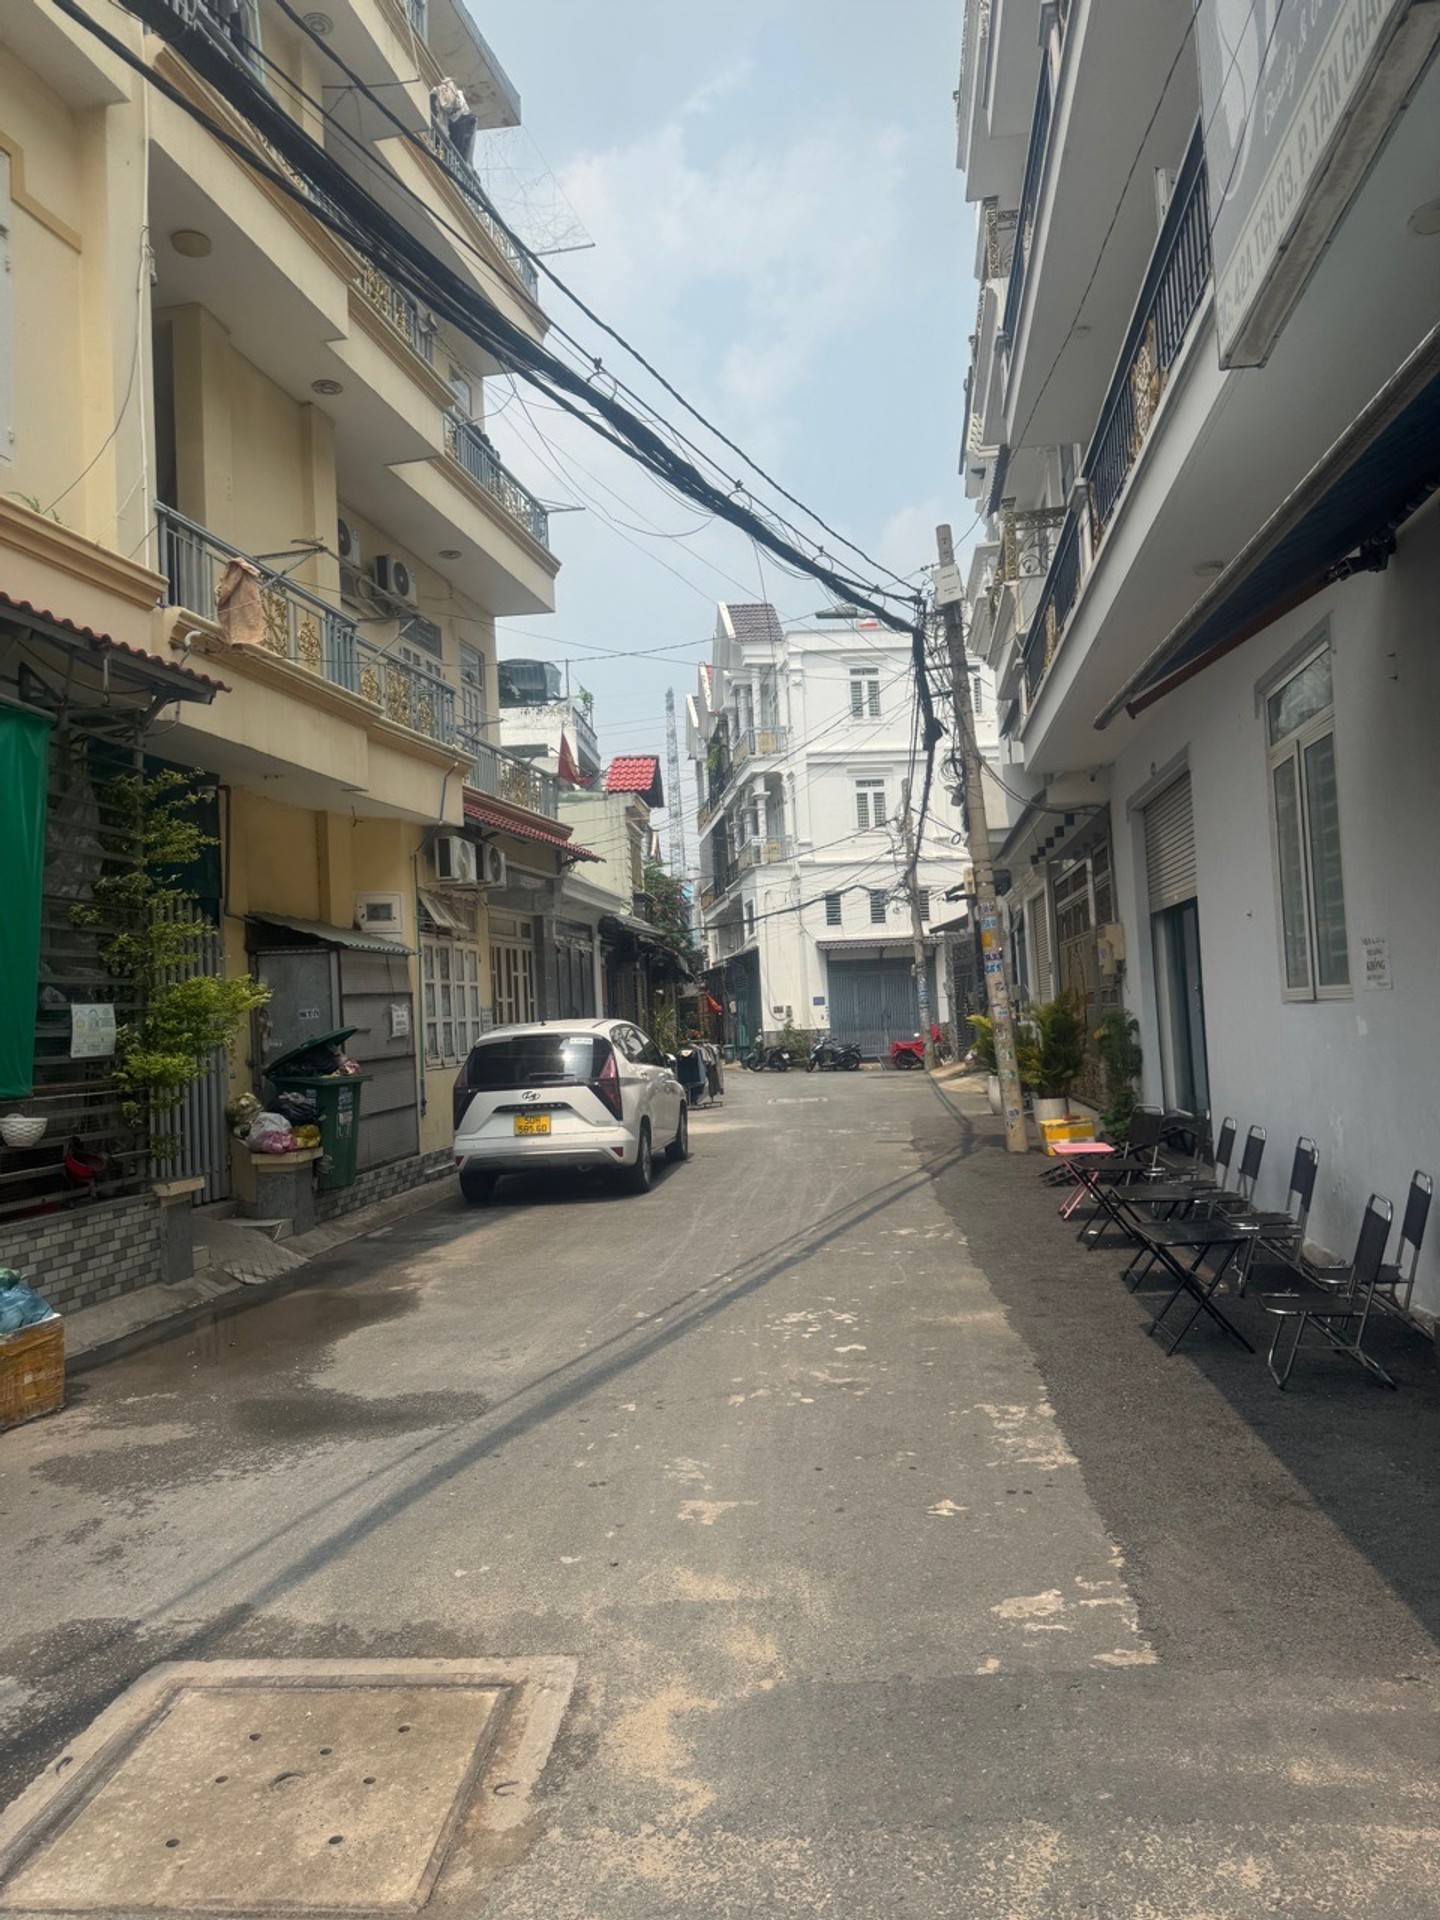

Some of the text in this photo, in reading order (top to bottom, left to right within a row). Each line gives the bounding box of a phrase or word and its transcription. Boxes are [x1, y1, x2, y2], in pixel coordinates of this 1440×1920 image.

[1234, 245, 1255, 305] 42A
[1253, 191, 1277, 266] TCH
[1276, 156, 1299, 219] 03,
[1299, 121, 1314, 177] P.
[1309, 55, 1341, 148] TÂN
